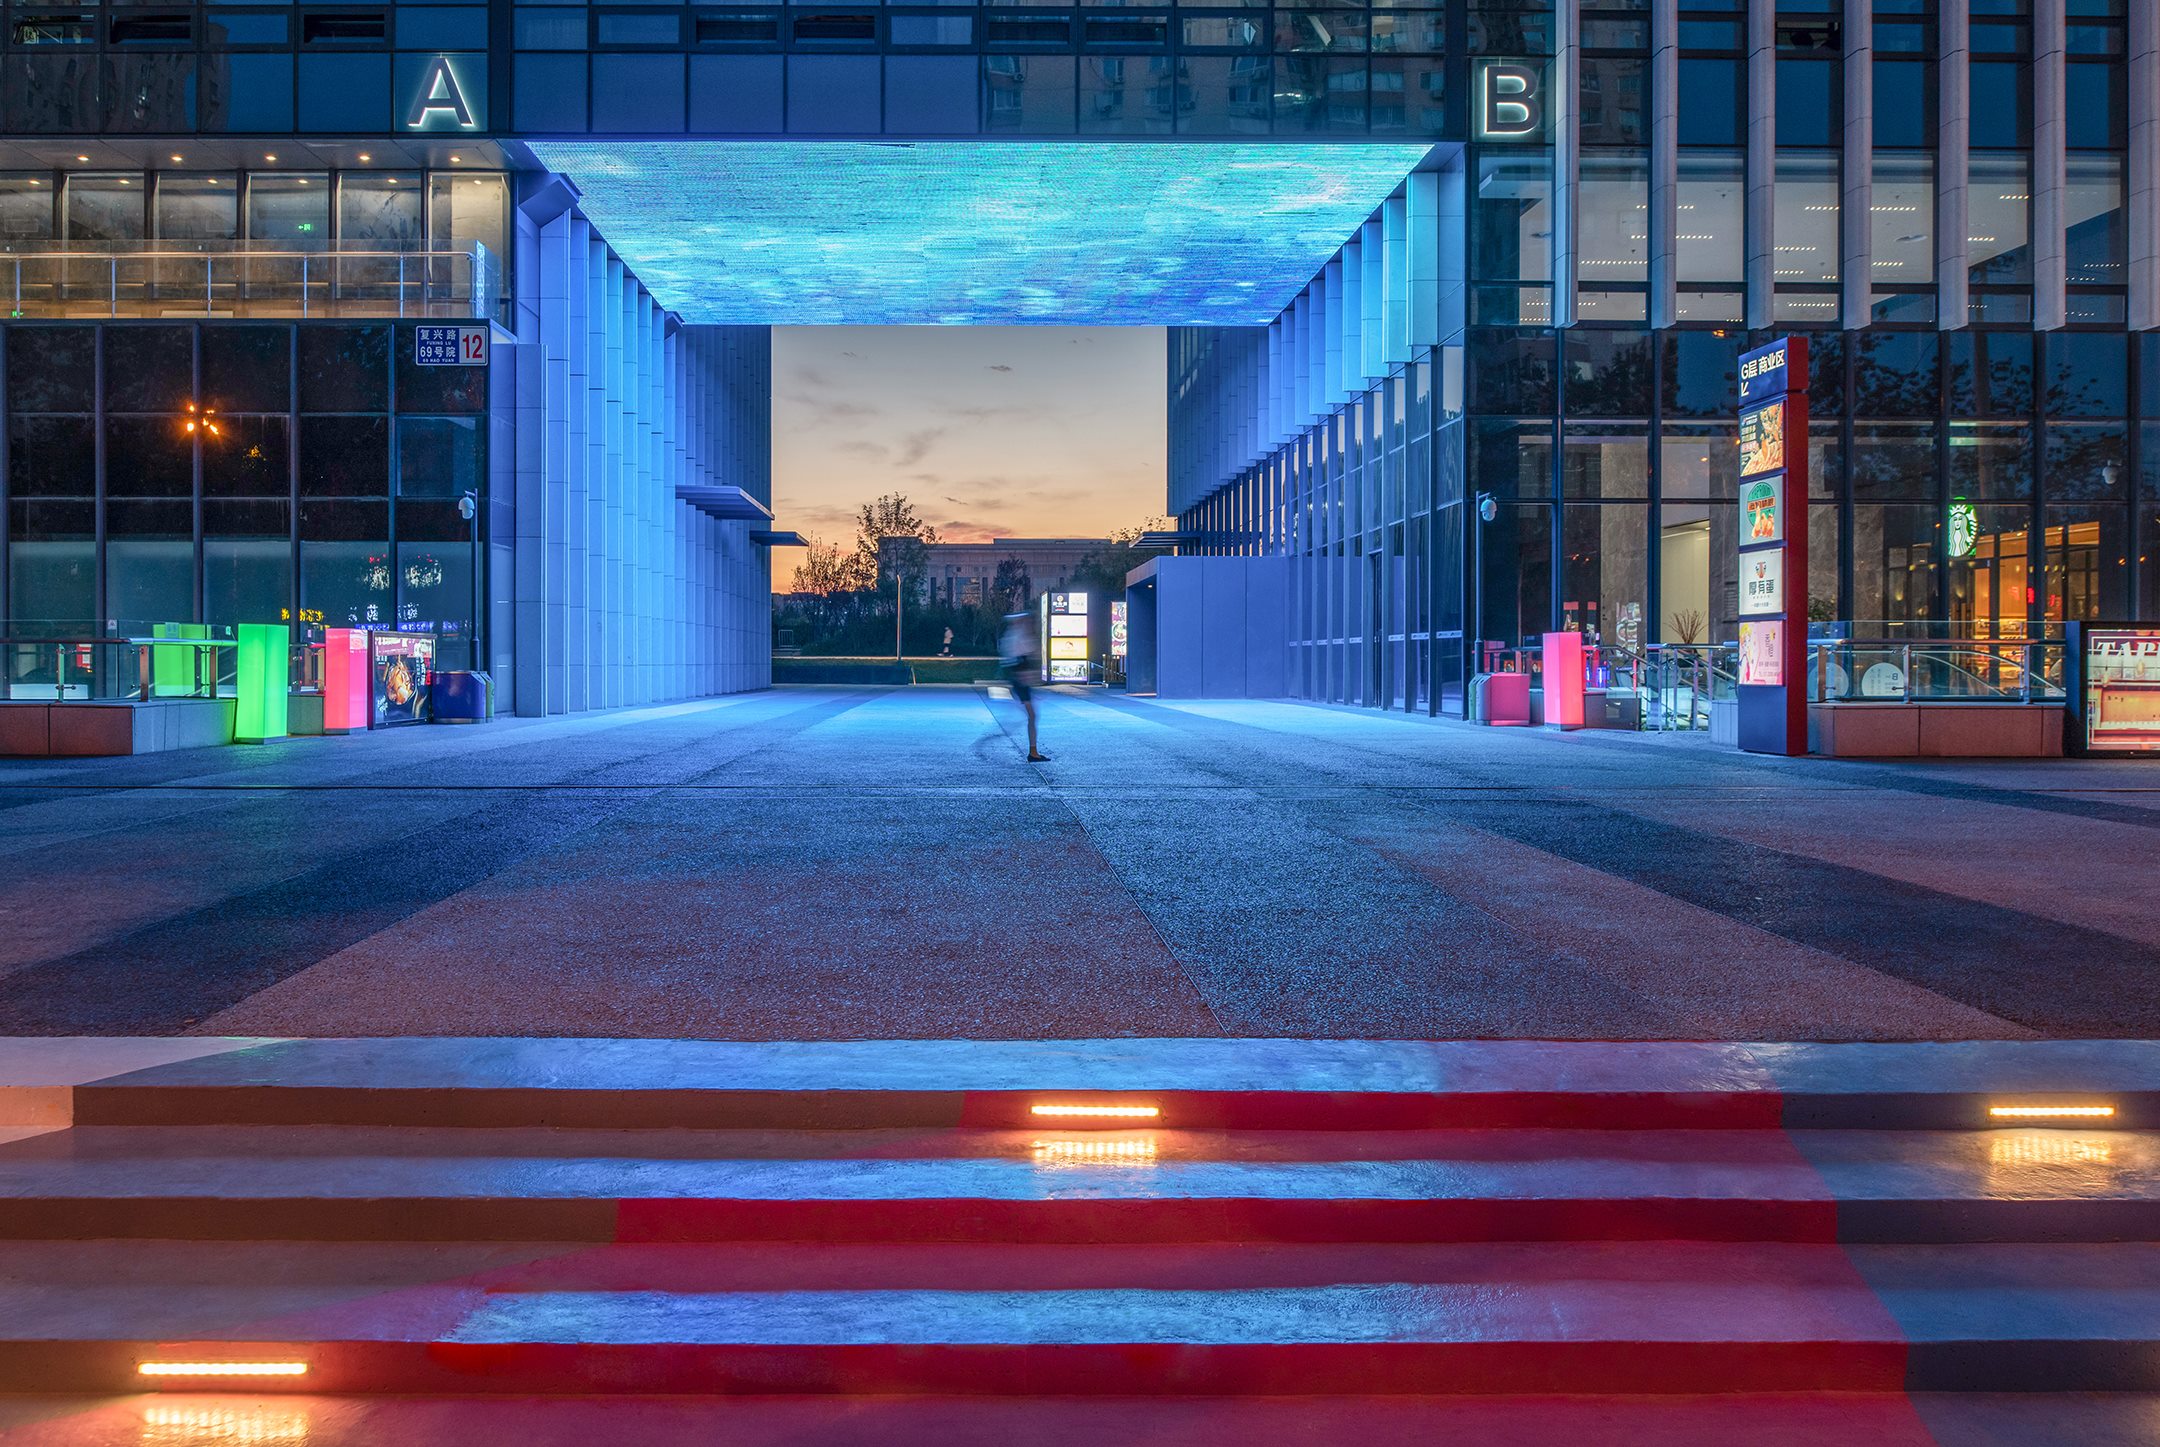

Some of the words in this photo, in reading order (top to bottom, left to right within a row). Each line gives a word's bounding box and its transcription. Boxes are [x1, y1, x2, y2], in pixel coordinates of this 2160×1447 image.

[408, 58, 474, 126] A
[1485, 65, 1540, 134] B
[420, 329, 456, 340] 复兴路
[420, 346, 456, 358] 69号院
[462, 335, 483, 358] 12
